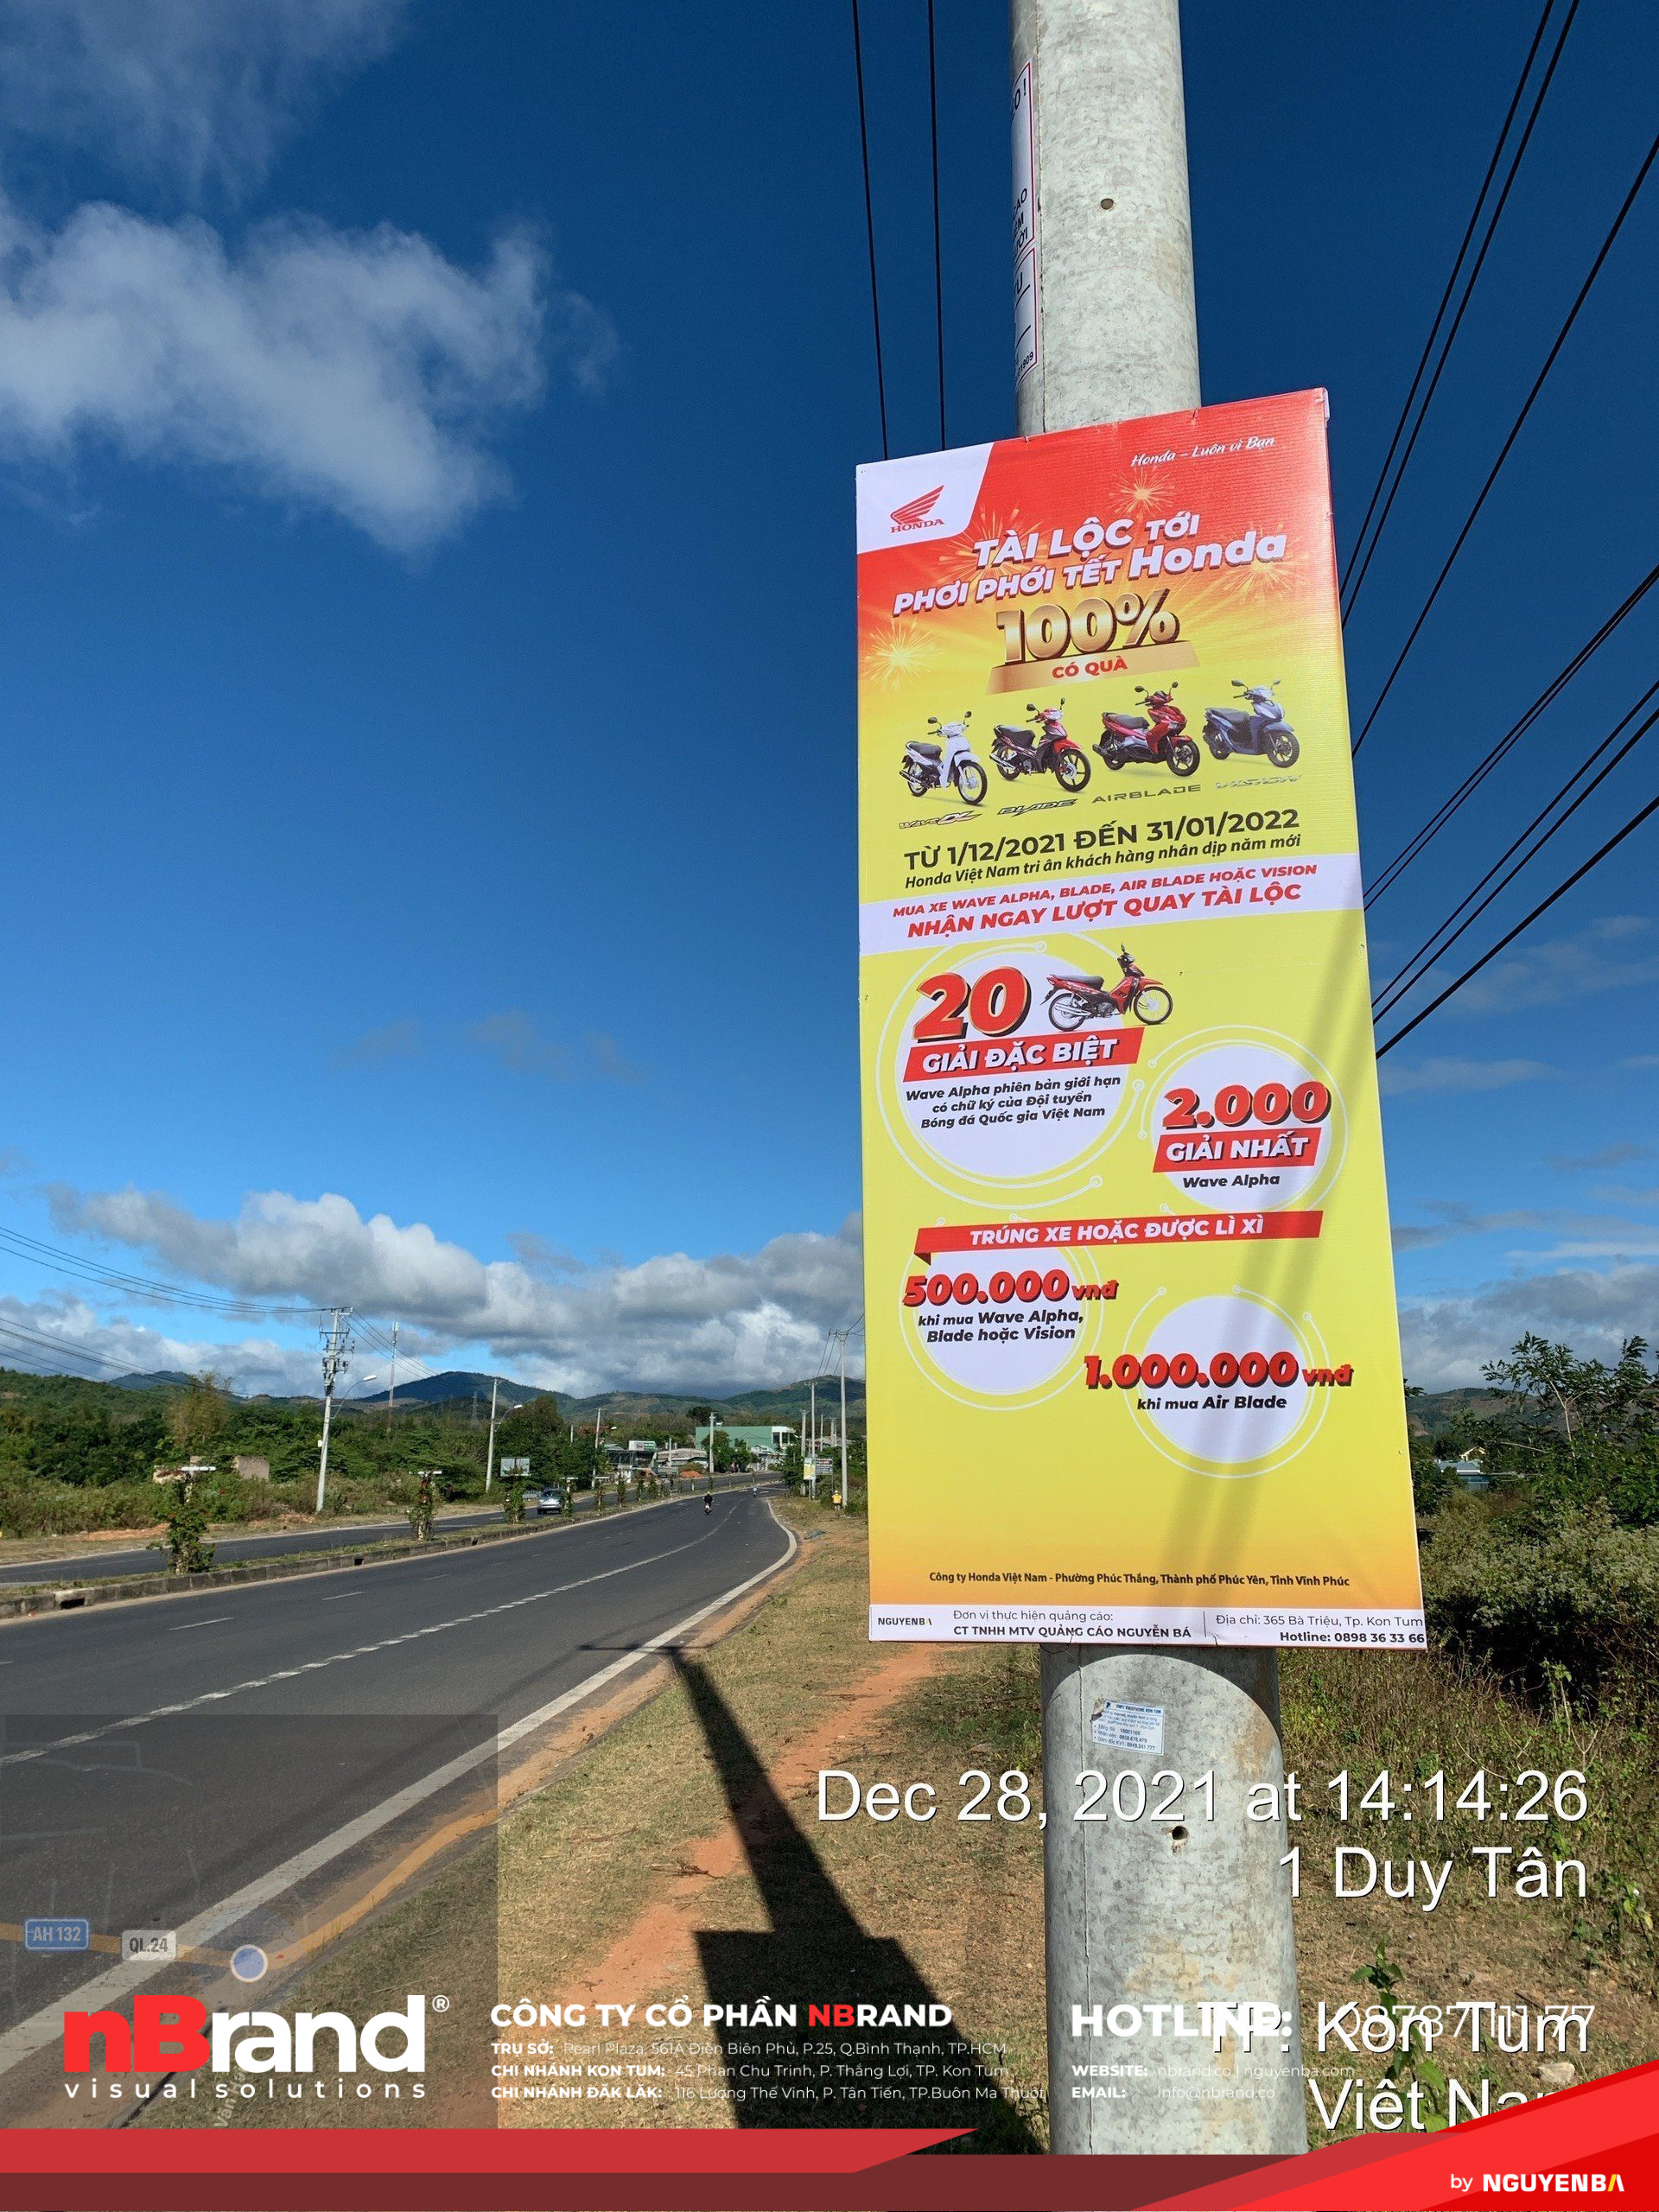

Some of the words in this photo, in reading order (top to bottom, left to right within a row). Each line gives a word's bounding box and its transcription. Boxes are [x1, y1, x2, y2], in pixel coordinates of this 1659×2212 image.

[1130, 449, 1175, 467] Honda
[1192, 442, 1225, 457] Luôn
[1230, 439, 1243, 451] vì
[1247, 434, 1274, 453] Bạn
[891, 518, 944, 533] HONDA
[973, 530, 1037, 569] TÀI
[1051, 516, 1133, 558] LỘC
[1143, 514, 1198, 543] TỚI
[893, 581, 968, 616] PHƠI
[976, 565, 1052, 599] PHỚI
[1064, 556, 1121, 591] TẾT
[1129, 530, 1287, 579] Honda
[996, 588, 1180, 665] 100%
[1052, 662, 1081, 679] CÓ
[1085, 657, 1128, 677] QUÀ
[1092, 785, 1201, 804] AIRBLADE
[905, 845, 940, 870] TỪ
[947, 832, 1065, 866] 1/12/2021
[1074, 820, 1136, 849] ĐẾN
[1147, 809, 1300, 841] 31/01/2022
[906, 870, 950, 888] Honda
[956, 866, 982, 883] Việt
[986, 863, 1020, 878] Nam
[1024, 861, 1039, 874] tri
[1043, 859, 1061, 872] ân
[1065, 851, 1111, 868] khách
[1116, 848, 1154, 863] hàng
[1158, 843, 1198, 859] nhân
[1203, 841, 1226, 856] dịp
[1230, 837, 1267, 851] năm
[1270, 834, 1300, 848] mới
[893, 905, 925, 918] MUA
[928, 901, 947, 913] XE
[951, 896, 996, 911] WAVE
[999, 889, 1054, 904] ALPHA,
[1059, 883, 1115, 899] BLADE,
[1119, 880, 1147, 892] AIR
[1151, 874, 1205, 888] BLADE
[1209, 867, 1256, 883] HOẶC
[1261, 864, 1318, 878] VISION
[907, 913, 975, 938] NHẬN
[980, 907, 1047, 930] NGAY
[1052, 899, 1118, 923] LƯỢT
[1123, 893, 1197, 917] QUAY
[1202, 885, 1243, 906] TÀI
[1249, 881, 1302, 906] LỘC
[912, 966, 1032, 1043] 20
[922, 1044, 978, 1074] GIẢI
[984, 1041, 1045, 1072] ĐẶC
[1052, 1035, 1118, 1066] BIỆT
[906, 1090, 944, 1101] Wave
[948, 1086, 989, 1100] Alpha
[994, 1083, 1031, 1098] phiên
[1034, 1078, 1062, 1090] bản
[1065, 1078, 1090, 1090] giới
[1094, 1076, 1121, 1087] hạn
[1162, 1080, 1332, 1130] 2.000
[1166, 1135, 1224, 1162] GIẢI
[1230, 1131, 1309, 1160] NHẤT
[1183, 1177, 1227, 1188] Wave
[1231, 1174, 1281, 1188] Alpha
[969, 1225, 1039, 1245] TRÚNG
[1044, 1226, 1071, 1242] XE
[1077, 1219, 1139, 1243] HOẶC
[1144, 1218, 1210, 1241] ĐƯỢC
[1215, 1215, 1236, 1235] LÌ
[1240, 1214, 1264, 1234] XÌ
[918, 1314, 940, 1326] khi
[943, 1315, 973, 1325] mua
[978, 1312, 1024, 1324] Wave
[1028, 1310, 1084, 1324] Alpha,
[927, 1331, 974, 1343] Blade
[977, 1329, 1019, 1344] hoặc
[1024, 1326, 1076, 1340] Vision
[1137, 1398, 1160, 1410] khi
[1165, 1399, 1198, 1409] mua
[1202, 1396, 1228, 1409] Air
[1234, 1395, 1287, 1408] Blade
[929, 1572, 954, 1584] Công
[957, 1573, 966, 1584] ty
[969, 1573, 1001, 1582] Honda
[1003, 1572, 1022, 1585] Việt
[1024, 1573, 1047, 1582] Nam
[1055, 1573, 1095, 1585] Phường
[1096, 1573, 1122, 1583] Phúc
[1160, 1573, 1193, 1585] Thành
[1196, 1573, 1217, 1586] phố
[1218, 1573, 1244, 1585] Phúc
[1246, 1574, 1268, 1586] Yên,
[953, 1625, 969, 1636] CT
[971, 1625, 1005, 1636] TNHH
[1008, 1626, 1035, 1636] MTV
[1038, 1624, 1084, 1638] QUẢNG
[1086, 1624, 1114, 1637] CÁO
[1116, 1624, 1169, 1638] NGUYỄN
[1173, 1625, 1192, 1637] BÁ
[1216, 1615, 1236, 1625] Địa
[1263, 1616, 1285, 1624] 365
[1288, 1616, 1304, 1625] Bà
[1307, 1616, 1342, 1627] Triệu,
[1344, 1617, 1363, 1628] Tp.
[1367, 1617, 1390, 1626] Kon
[1394, 1618, 1423, 1626] Tum
[1280, 1631, 1331, 1643] Hotline:
[1334, 1632, 1368, 1643] 0898
[1370, 1633, 1386, 1643] 36
[1389, 1633, 1405, 1643] 33
[1408, 1633, 1425, 1643] 66
